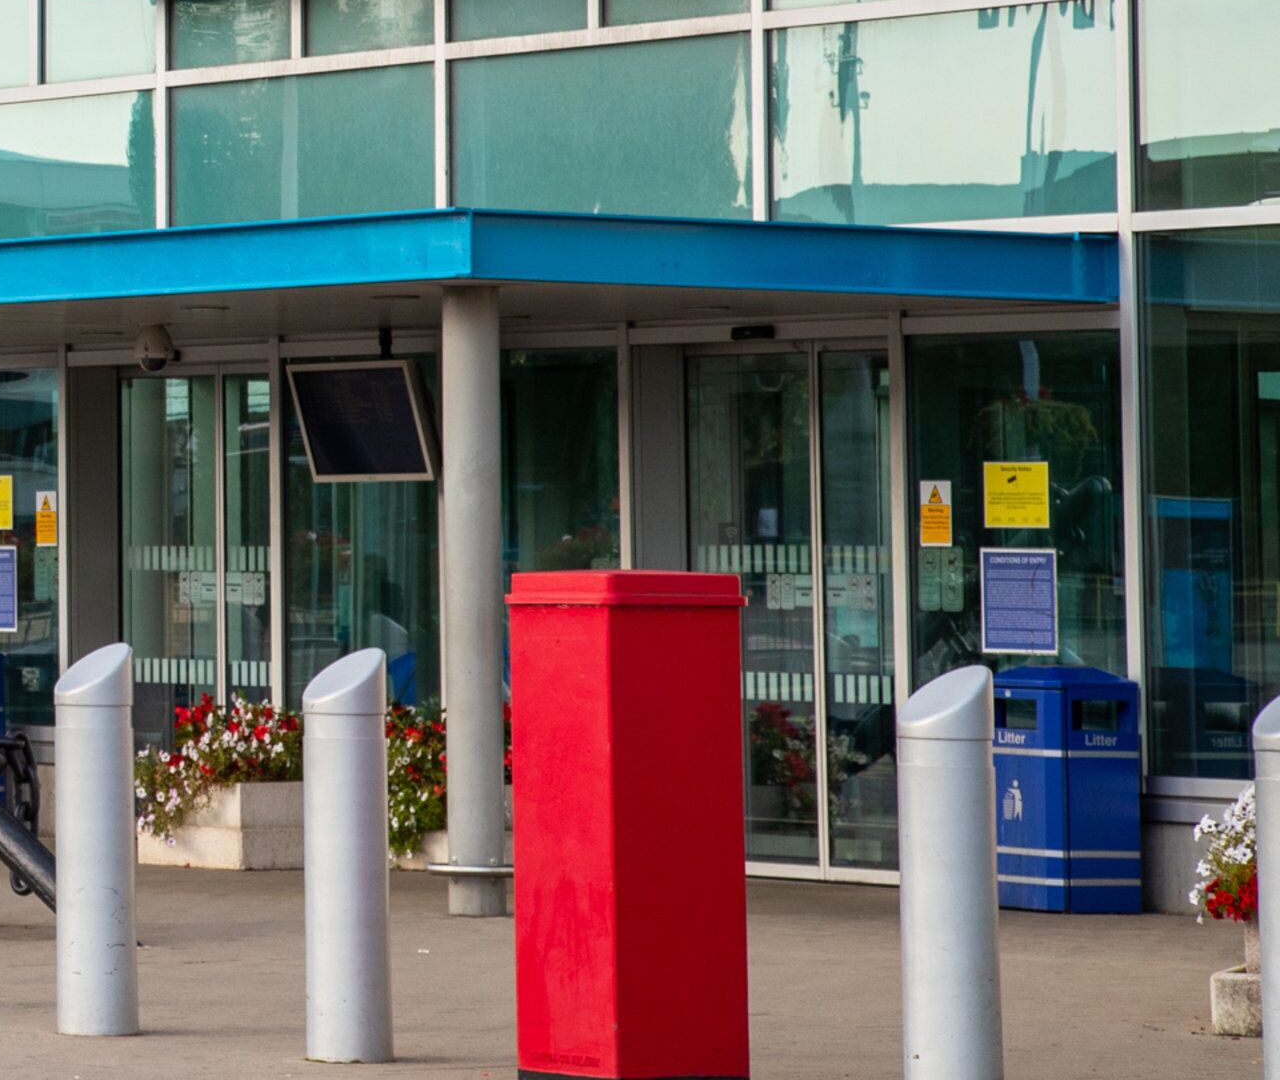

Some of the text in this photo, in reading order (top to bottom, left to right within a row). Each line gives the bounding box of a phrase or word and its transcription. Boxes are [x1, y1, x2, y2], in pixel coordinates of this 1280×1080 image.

[989, 555, 1047, 565] CONDITIONS OF ENTRY
[997, 731, 1026, 745] Litter
[1084, 734, 1118, 747] Litter
